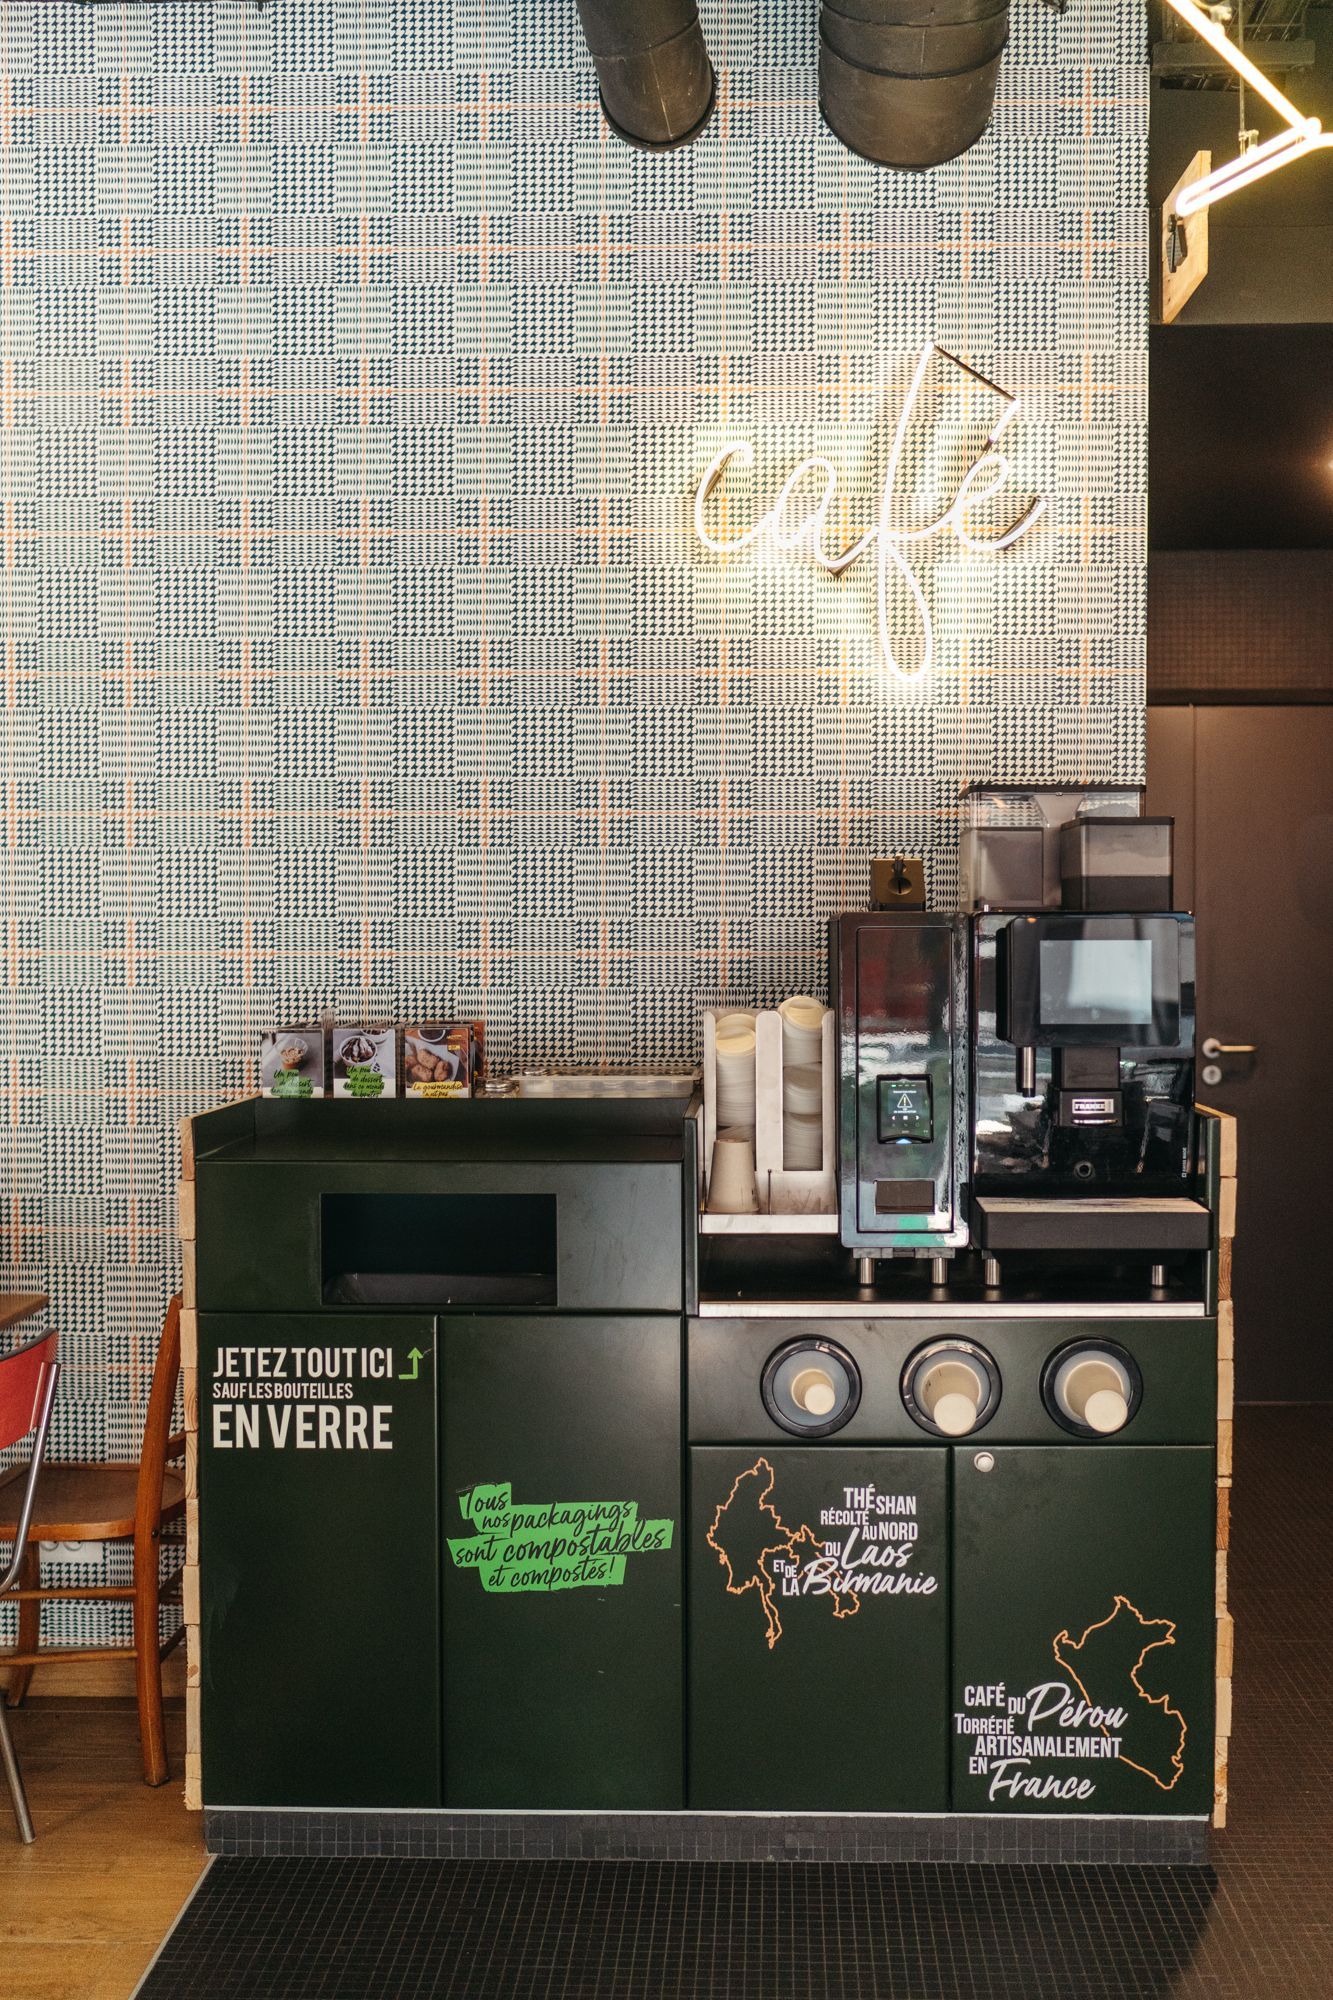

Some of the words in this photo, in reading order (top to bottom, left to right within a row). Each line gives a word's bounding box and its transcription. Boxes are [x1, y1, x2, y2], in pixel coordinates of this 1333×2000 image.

[212, 1347, 288, 1378] JETEZ
[291, 1347, 357, 1378] TOUT
[361, 1347, 393, 1378] ICI
[212, 1382, 247, 1399] SAUF
[248, 1382, 273, 1399] LES
[274, 1382, 354, 1399] BOUTEILLES
[212, 1404, 260, 1449] EN
[266, 1404, 393, 1449] VERRE
[843, 1483, 876, 1509] THÉ
[876, 1496, 917, 1515] SHAN
[481, 1513, 510, 1530] nos
[510, 1500, 633, 1538] packagings
[820, 1507, 870, 1526] RÉCOLTÉ
[862, 1525, 878, 1540] AU
[879, 1522, 918, 1540] NORD
[455, 1535, 511, 1565] sont
[502, 1520, 666, 1565] compostables
[825, 1542, 841, 1557] DU
[841, 1527, 913, 1570] Laos
[488, 1566, 515, 1587] et
[773, 1560, 785, 1573] ET
[785, 1564, 797, 1578] DE
[782, 1579, 800, 1596] LA
[802, 1557, 939, 1595] Birmanie
[964, 1682, 1006, 1707] CAFÉ
[1008, 1697, 1026, 1715] DU
[1026, 1682, 1128, 1732] Pérou
[954, 1713, 1015, 1735] TORRÉFIÉ
[975, 1736, 1122, 1758] ARTISANALEMENT
[969, 1757, 988, 1775] EN
[989, 1758, 1096, 1801] France
